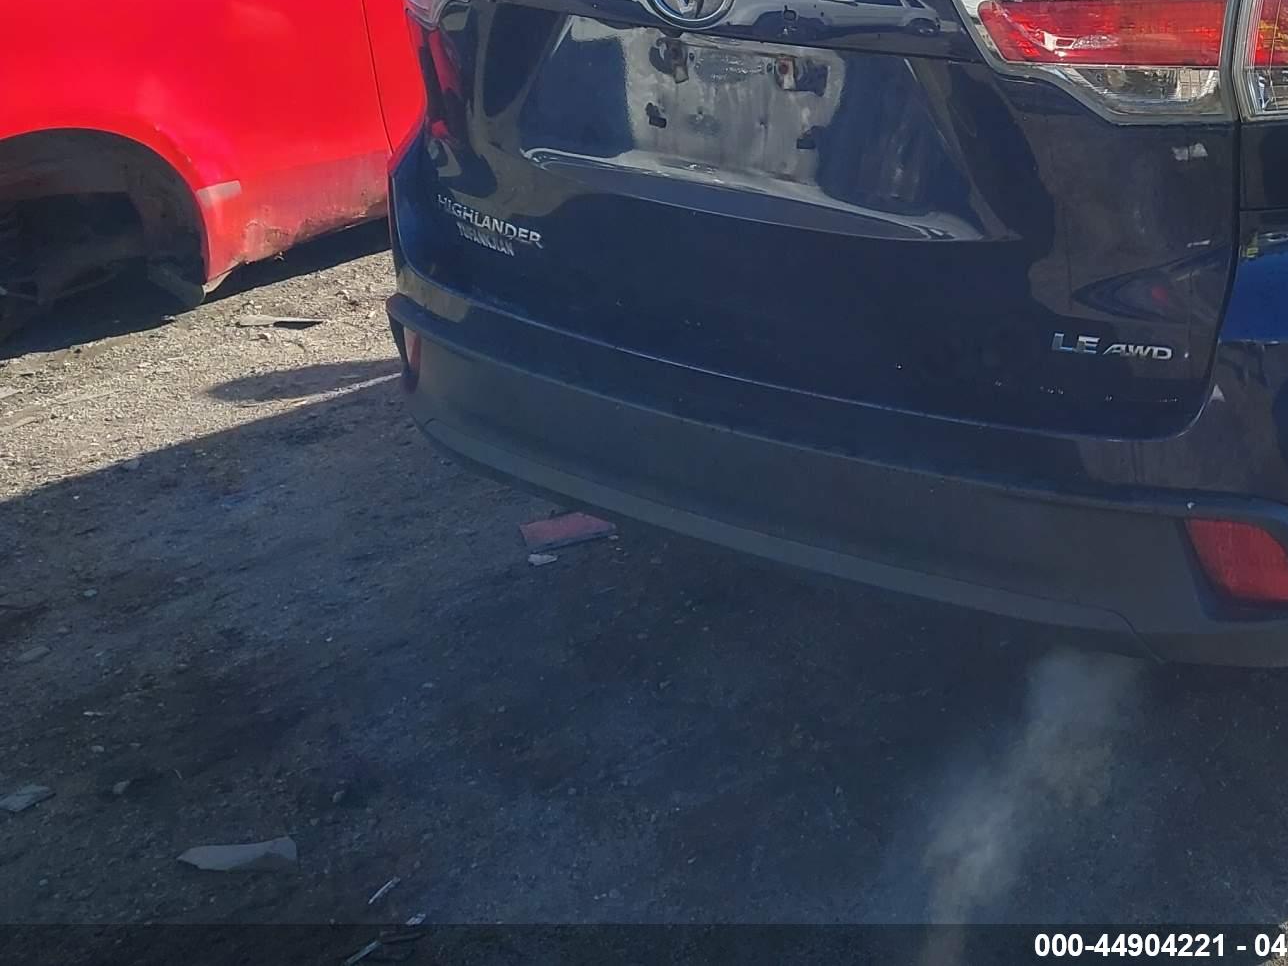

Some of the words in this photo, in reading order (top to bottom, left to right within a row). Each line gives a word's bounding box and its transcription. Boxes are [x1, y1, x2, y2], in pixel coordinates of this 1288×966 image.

[437, 194, 544, 249] HIGHLANDER
[1052, 332, 1100, 355] LE
[1102, 343, 1173, 360] AWD
